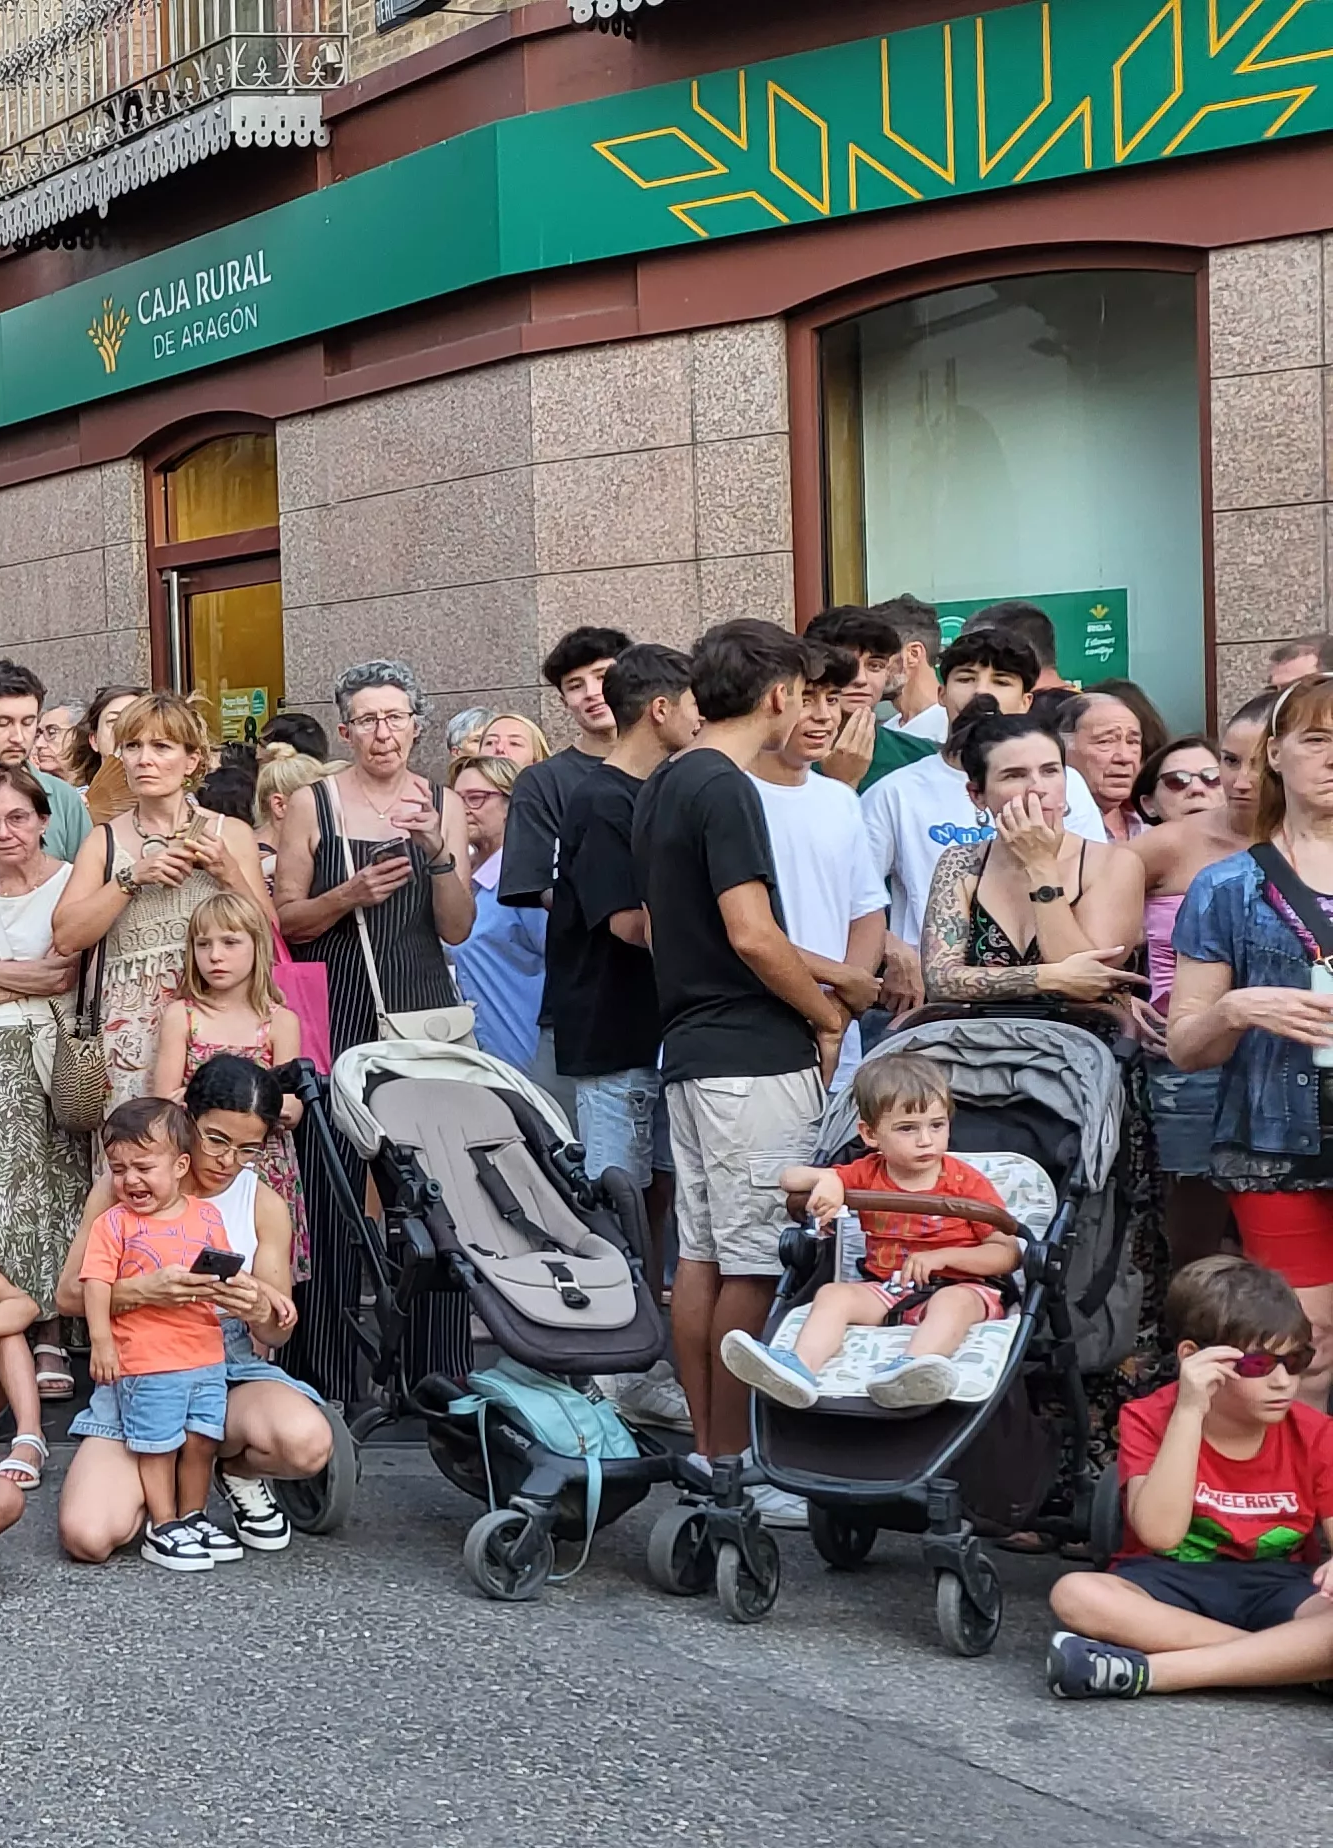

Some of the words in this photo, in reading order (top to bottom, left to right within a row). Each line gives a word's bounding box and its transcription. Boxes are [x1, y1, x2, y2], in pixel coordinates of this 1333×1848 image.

[137, 278, 191, 325] CAJA
[195, 249, 272, 306] RURAL
[153, 329, 176, 360] DE
[180, 302, 258, 351] ARAGÓN
